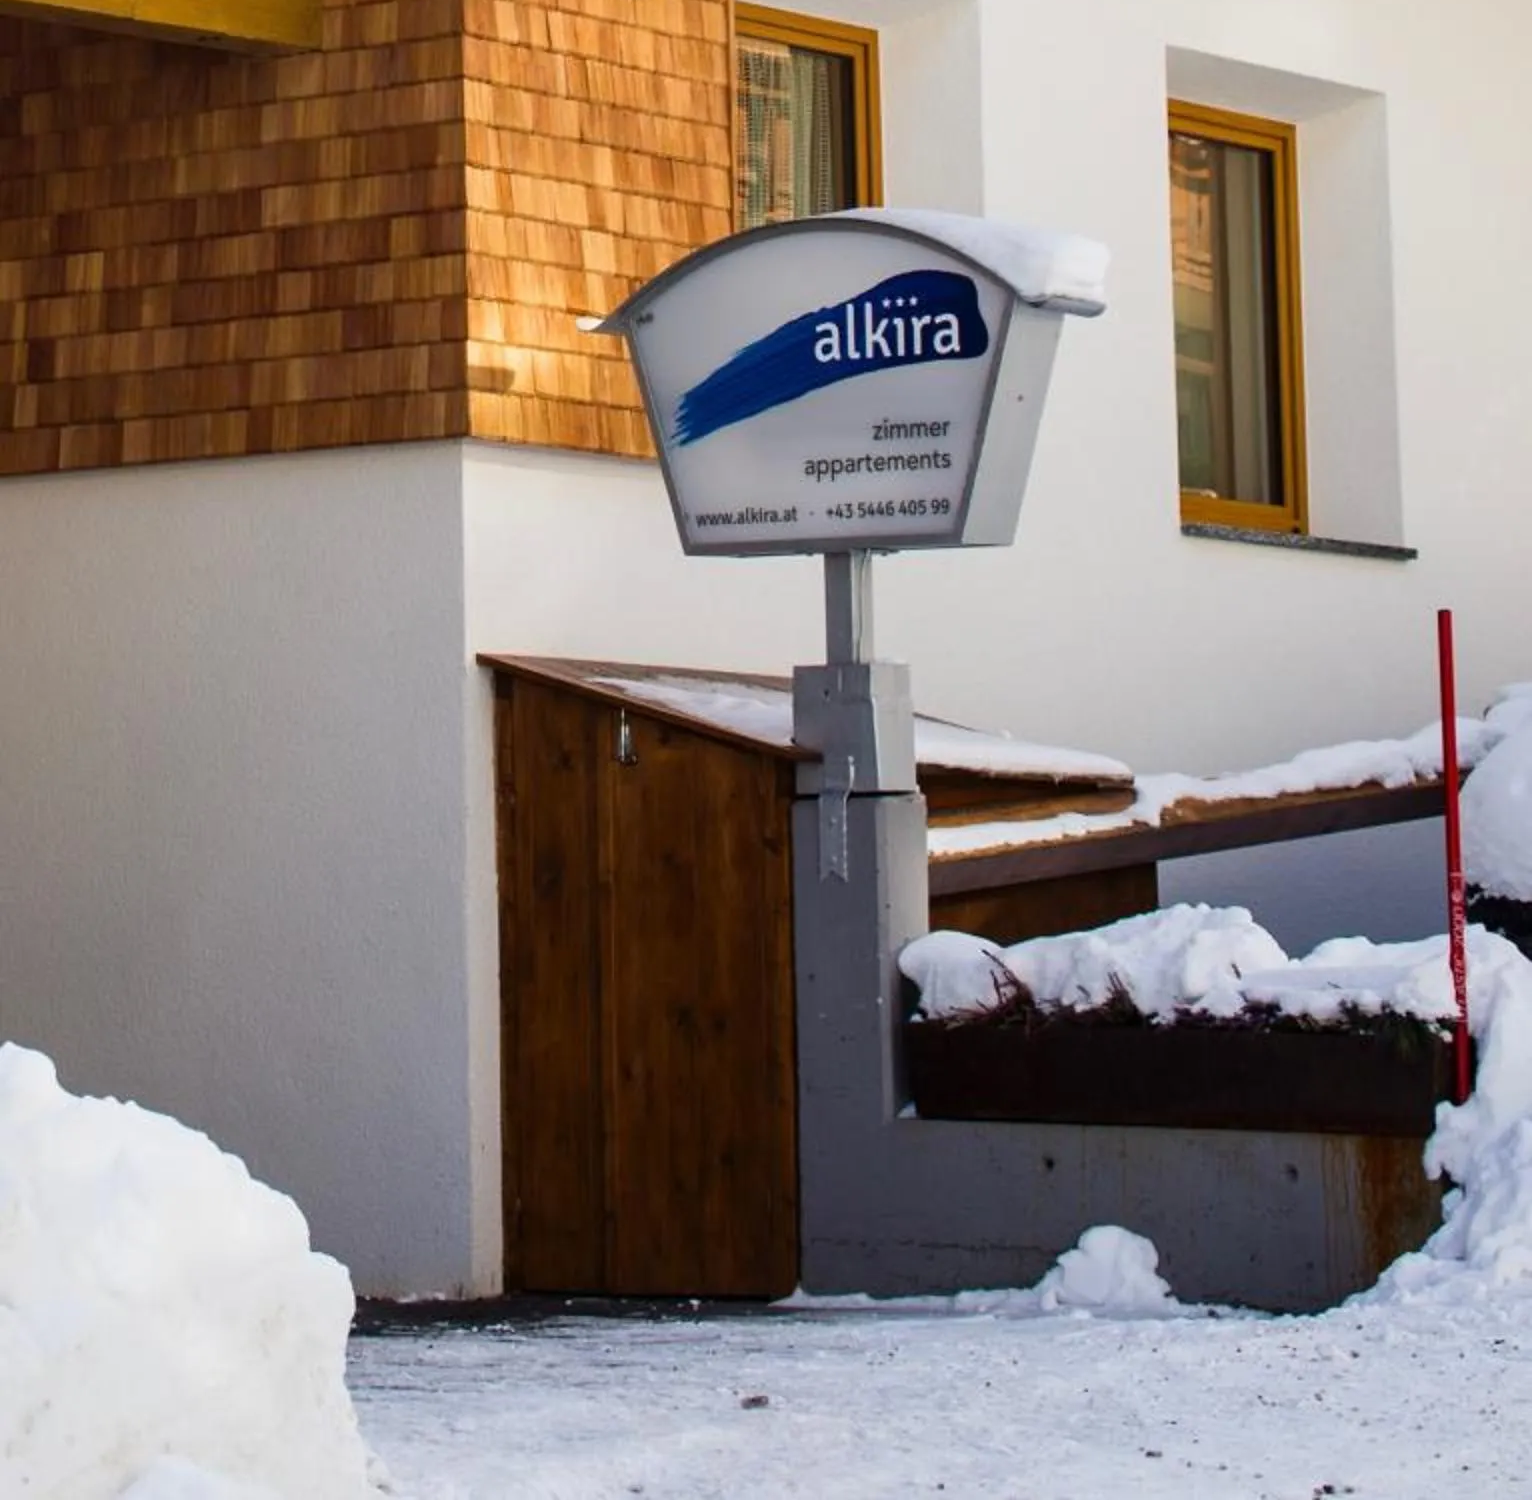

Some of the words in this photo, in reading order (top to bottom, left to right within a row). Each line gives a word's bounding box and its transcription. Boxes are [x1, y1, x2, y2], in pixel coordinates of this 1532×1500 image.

[872, 417, 950, 441] zimmer
[804, 451, 952, 482] appartements
[695, 506, 798, 528] www.alkira.at
[826, 503, 853, 520] +43
[857, 501, 895, 518] 5446
[897, 499, 927, 516] 405
[931, 498, 950, 514] 99
